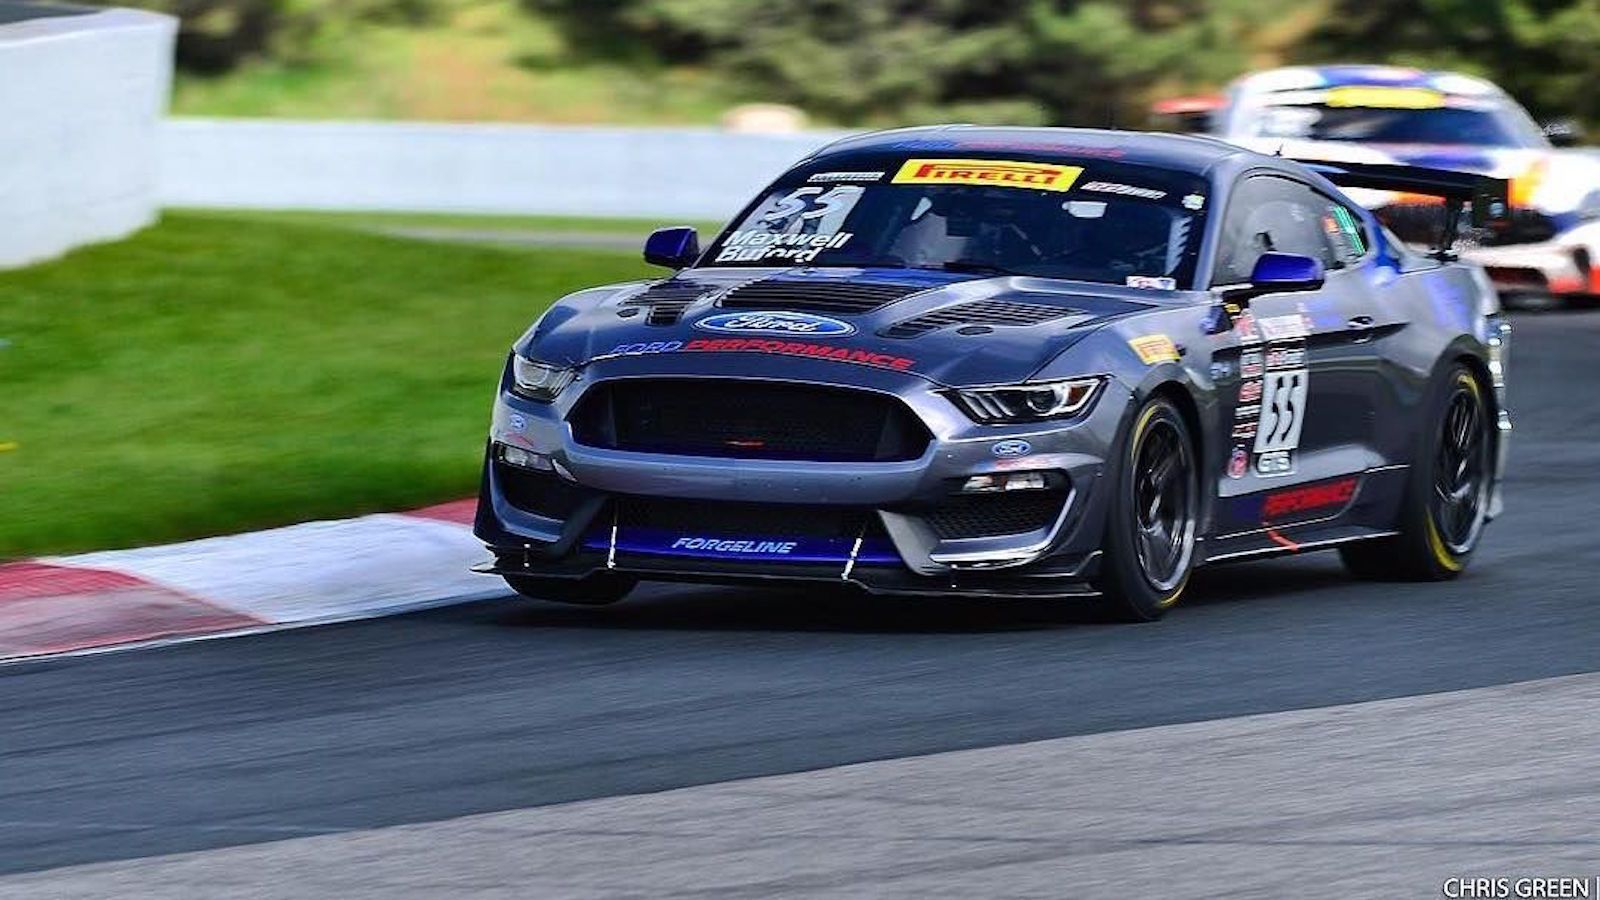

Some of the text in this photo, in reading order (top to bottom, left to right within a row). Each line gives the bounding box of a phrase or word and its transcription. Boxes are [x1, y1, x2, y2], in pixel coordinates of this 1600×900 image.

[915, 163, 1062, 185] PIRELLI
[721, 230, 854, 248] Maxwell
[715, 246, 825, 263] Buford
[724, 314, 822, 332] Ford
[611, 338, 917, 371] FORD PERFORMANCE
[1266, 374, 1301, 445] 55
[671, 537, 797, 554] FORGELINE
